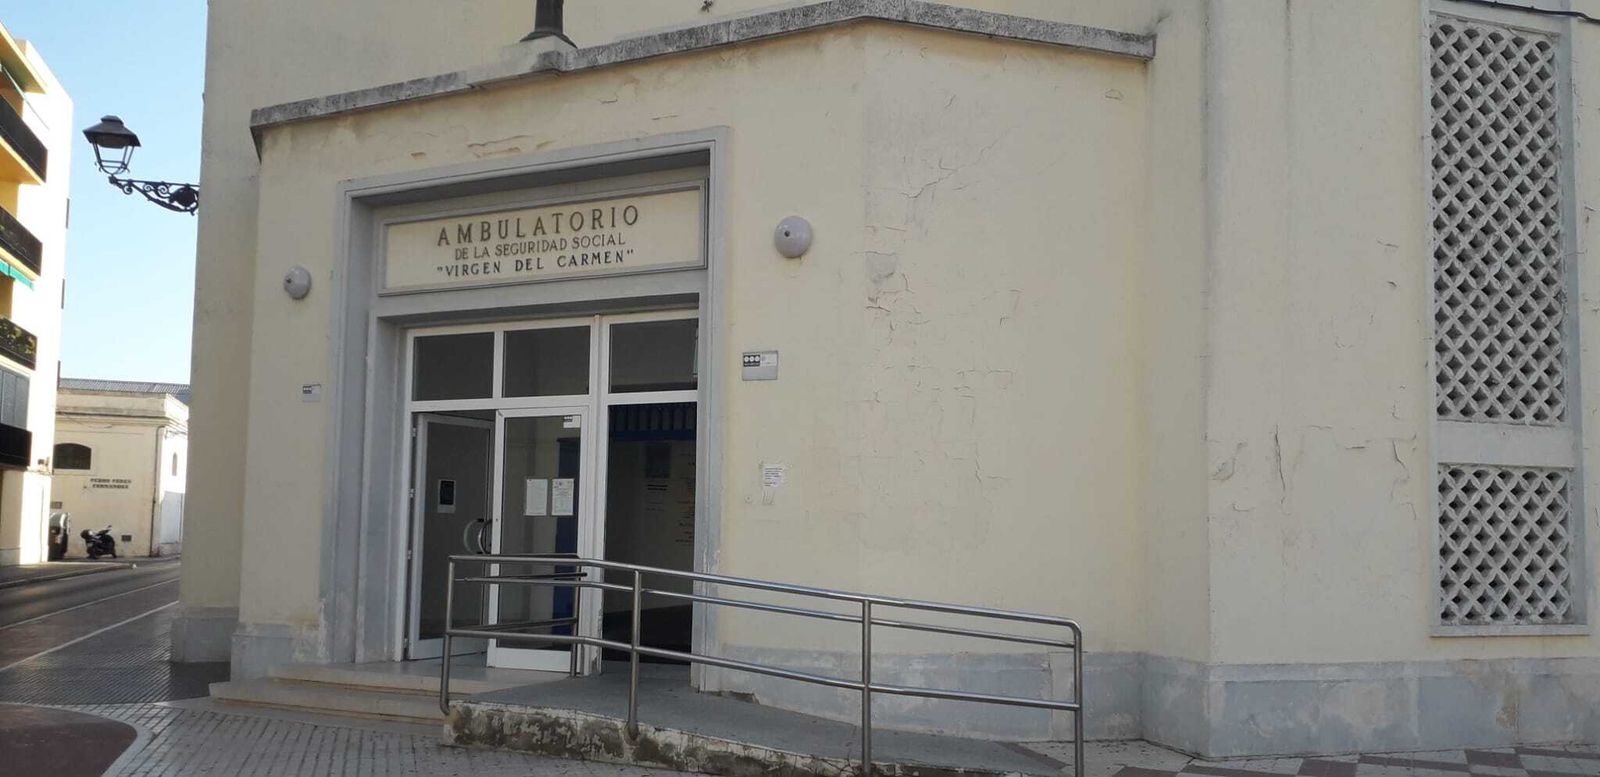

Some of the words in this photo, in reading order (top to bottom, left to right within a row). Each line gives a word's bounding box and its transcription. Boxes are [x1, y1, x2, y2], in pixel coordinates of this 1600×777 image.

[437, 205, 639, 246] AMBULATORIO
[455, 247, 468, 260] DE
[474, 244, 490, 259] LA
[495, 237, 568, 257] SEGURIDAD
[571, 232, 626, 250] SOCIAL
[437, 260, 501, 277] "VIRGEN
[515, 257, 544, 272] DEL
[557, 249, 634, 268] CARMEN"
